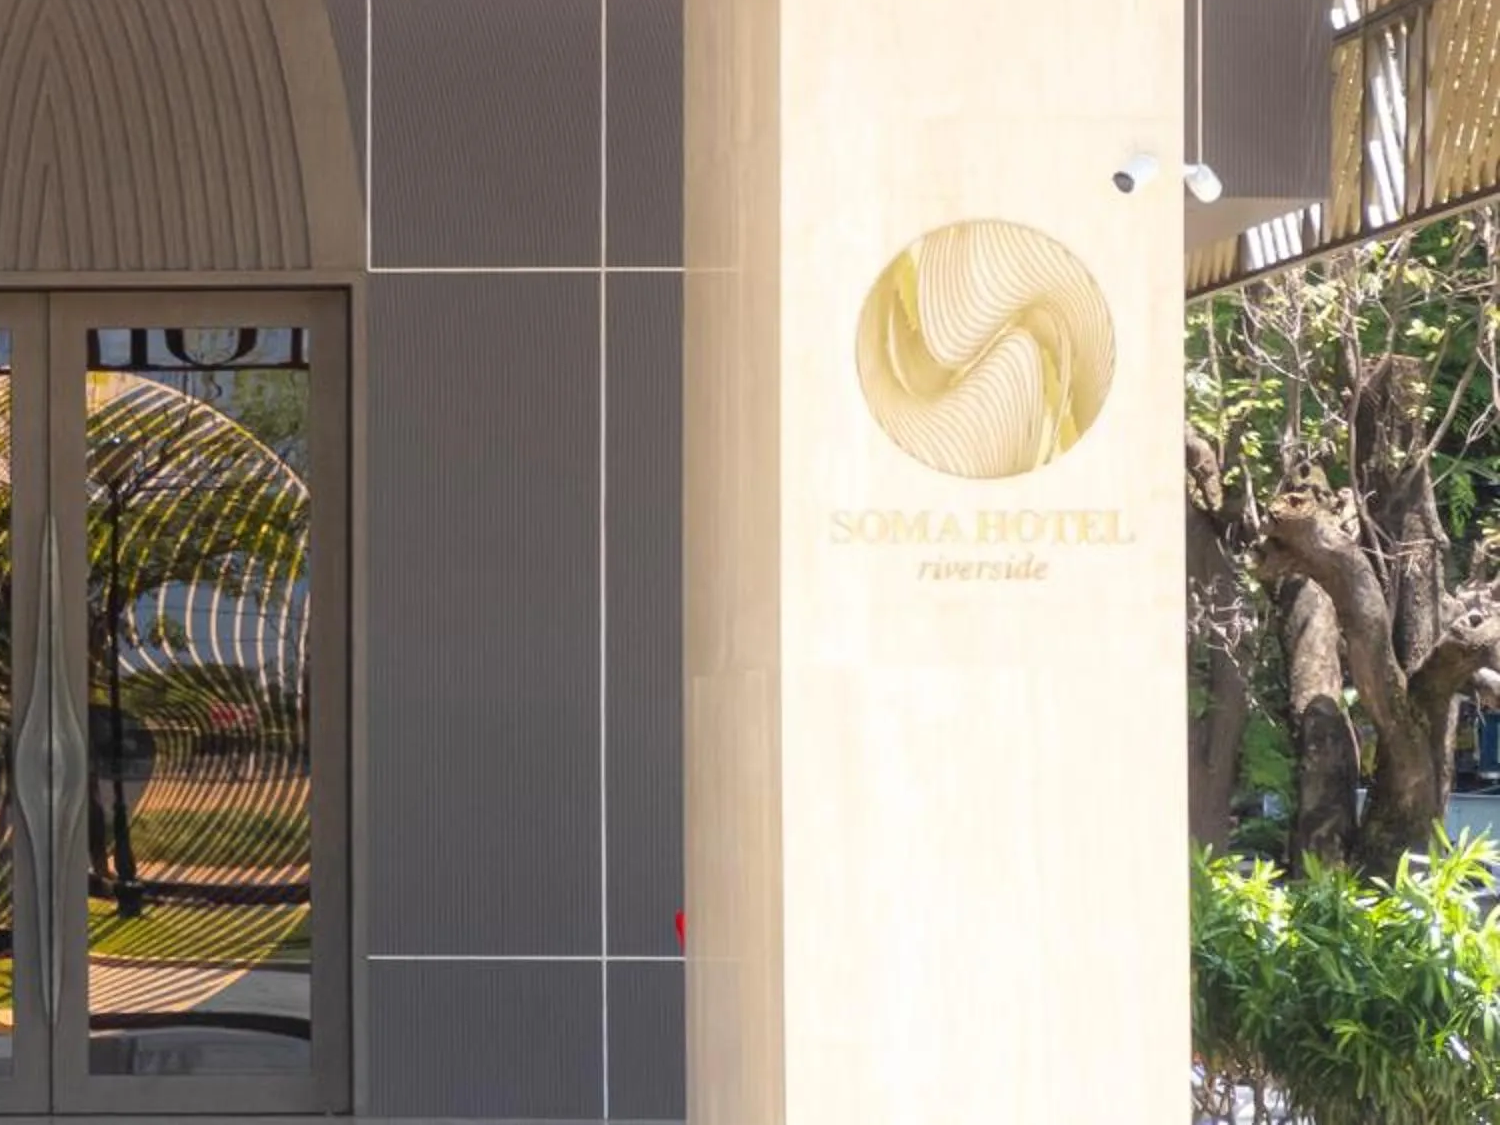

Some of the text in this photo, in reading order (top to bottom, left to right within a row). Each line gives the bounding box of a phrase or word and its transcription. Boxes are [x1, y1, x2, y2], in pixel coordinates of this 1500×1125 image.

[829, 508, 1137, 545] SOMA HOTEL
[916, 552, 1050, 582] riverside
